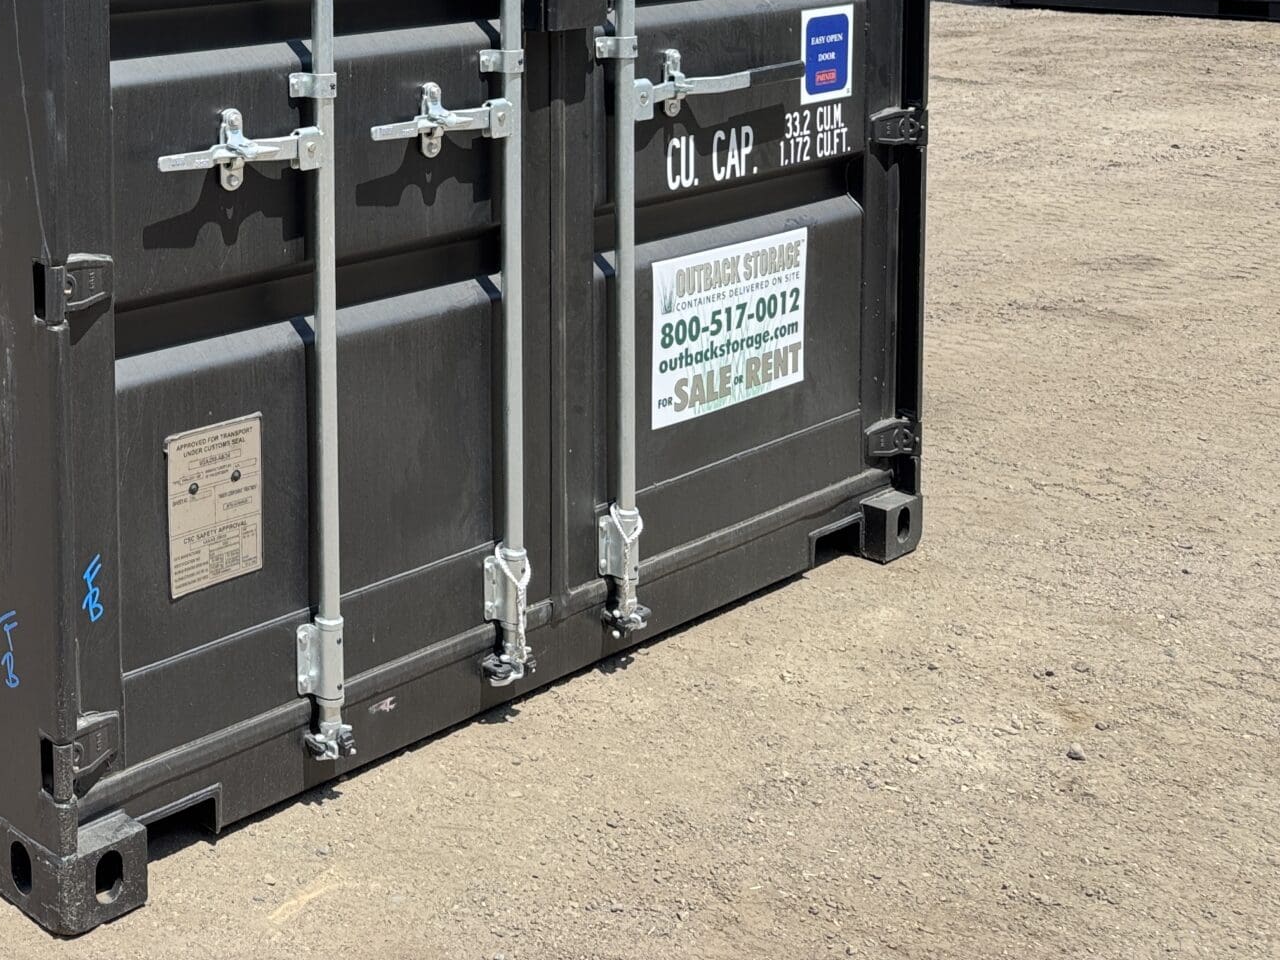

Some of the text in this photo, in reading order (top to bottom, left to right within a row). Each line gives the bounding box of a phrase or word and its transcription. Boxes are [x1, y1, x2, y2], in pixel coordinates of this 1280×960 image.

[810, 32, 844, 46] EASY OPEN
[817, 51, 836, 62] DOOR
[666, 103, 845, 191] CU. CAP. 33.2 CU.M.
[779, 127, 852, 167] 1,172 CU.FT.
[675, 240, 801, 298] OUTBACK STORAGE
[675, 271, 801, 311] CONTAINERS DELIVERED ON SITE
[660, 287, 801, 350] 800-517-0012
[658, 320, 799, 374] outbackstorage.com
[657, 341, 802, 413] FOR SALE OR RENT
[176, 426, 253, 452] APPROVED FOR TRANSPORT
[183, 436, 246, 458] UNDER CUSTOMS SEAL
[183, 535, 195, 545] CSC
[196, 528, 218, 540] SAFETY
[218, 519, 247, 533] APPROVAL
